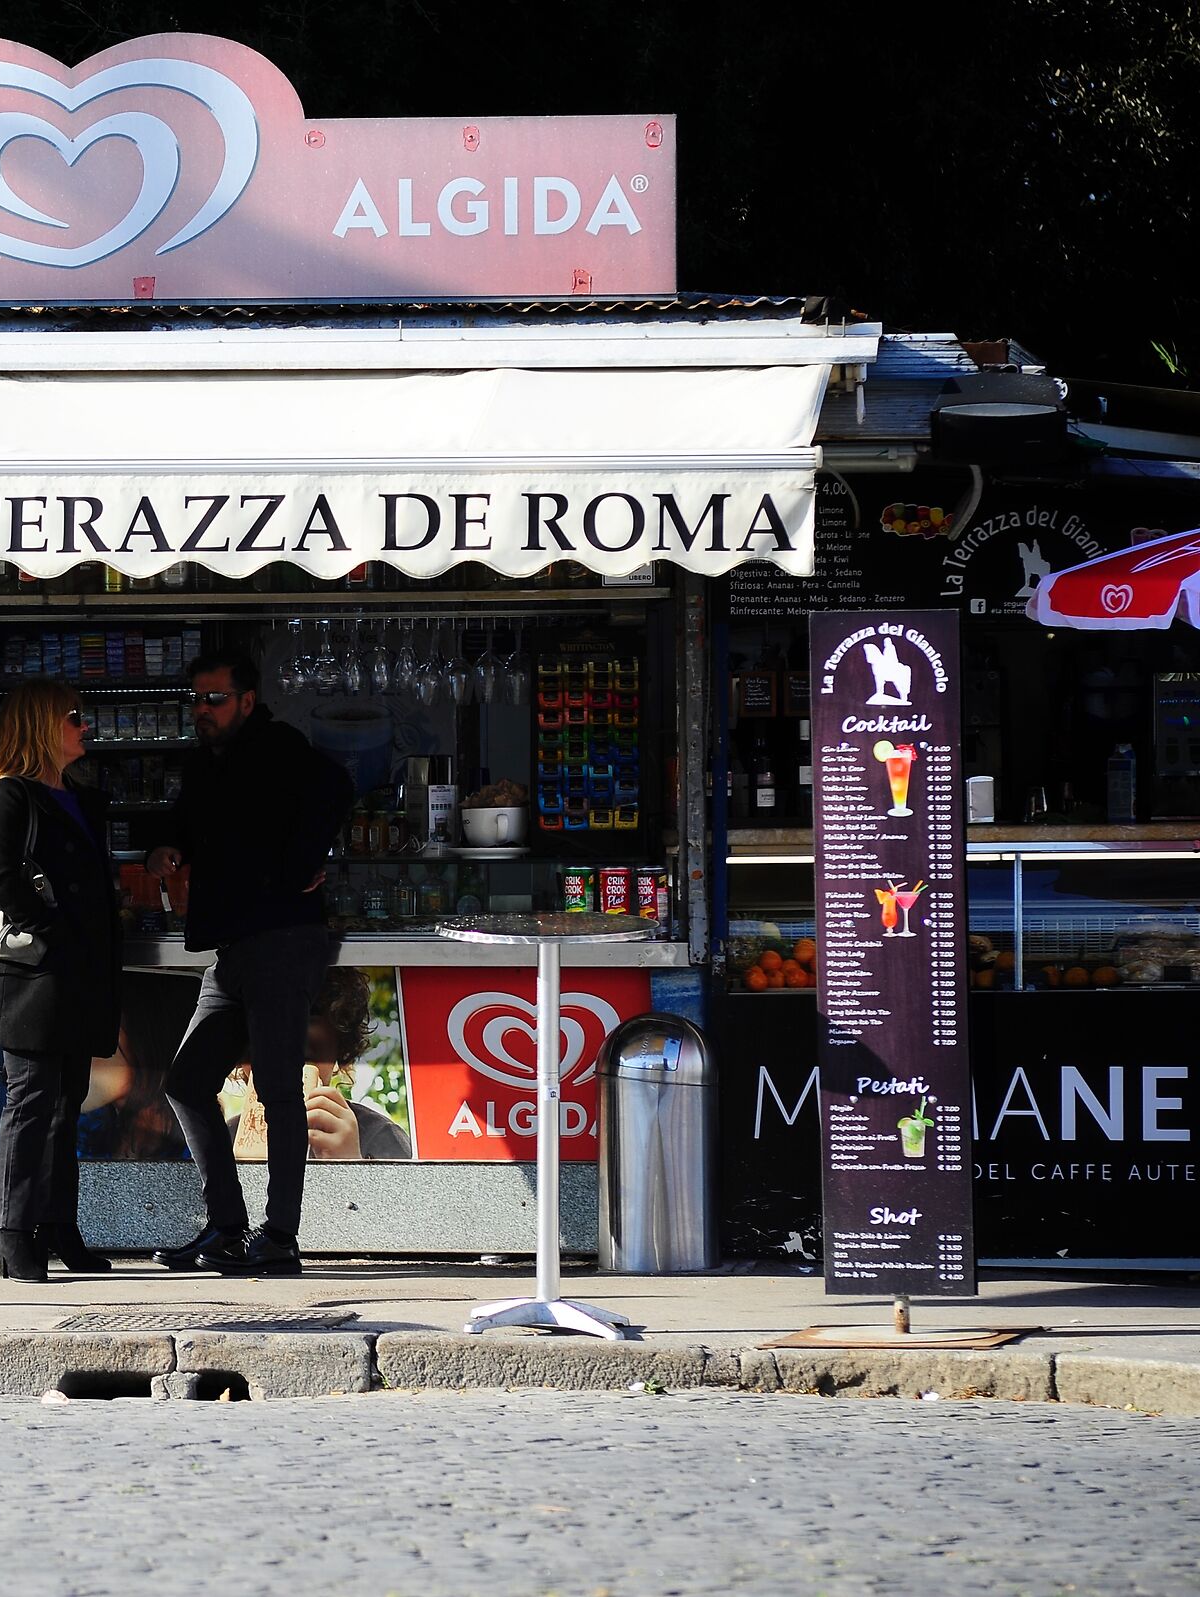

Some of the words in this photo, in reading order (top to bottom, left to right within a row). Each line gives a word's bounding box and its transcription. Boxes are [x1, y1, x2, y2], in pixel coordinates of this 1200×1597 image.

[378, 493, 493, 552] DE
[519, 491, 796, 552] ROMA
[822, 519, 847, 527] Limone
[1026, 505, 1058, 529] del
[942, 512, 1021, 568] Terrazza
[833, 555, 849, 563] Kiwi
[835, 568, 863, 577] Sedano
[767, 581, 794, 589] Ananas
[802, 581, 819, 589] Pera
[827, 581, 861, 589] Cannella
[940, 575, 964, 596] La
[774, 595, 801, 603] Ananas
[809, 595, 828, 603] Mela
[839, 595, 867, 603] Sedano
[875, 595, 906, 603] Zenzero
[787, 607, 816, 616] Melon
[878, 622, 904, 637] del
[823, 626, 876, 671] Terrazza
[905, 629, 949, 693] Gianicolo
[821, 675, 834, 694] La
[842, 714, 932, 733] Cocktail
[565, 885, 582, 894] CROK
[566, 876, 581, 885] CRIK
[606, 885, 626, 894] CROK
[607, 876, 625, 885] CRIK
[857, 1076, 930, 1095] Pestati
[753, 1064, 1191, 1142] MANE
[447, 1100, 597, 1139] ALGD
[1031, 1163, 1112, 1180] CAFFE
[870, 1207, 922, 1226] Shot
